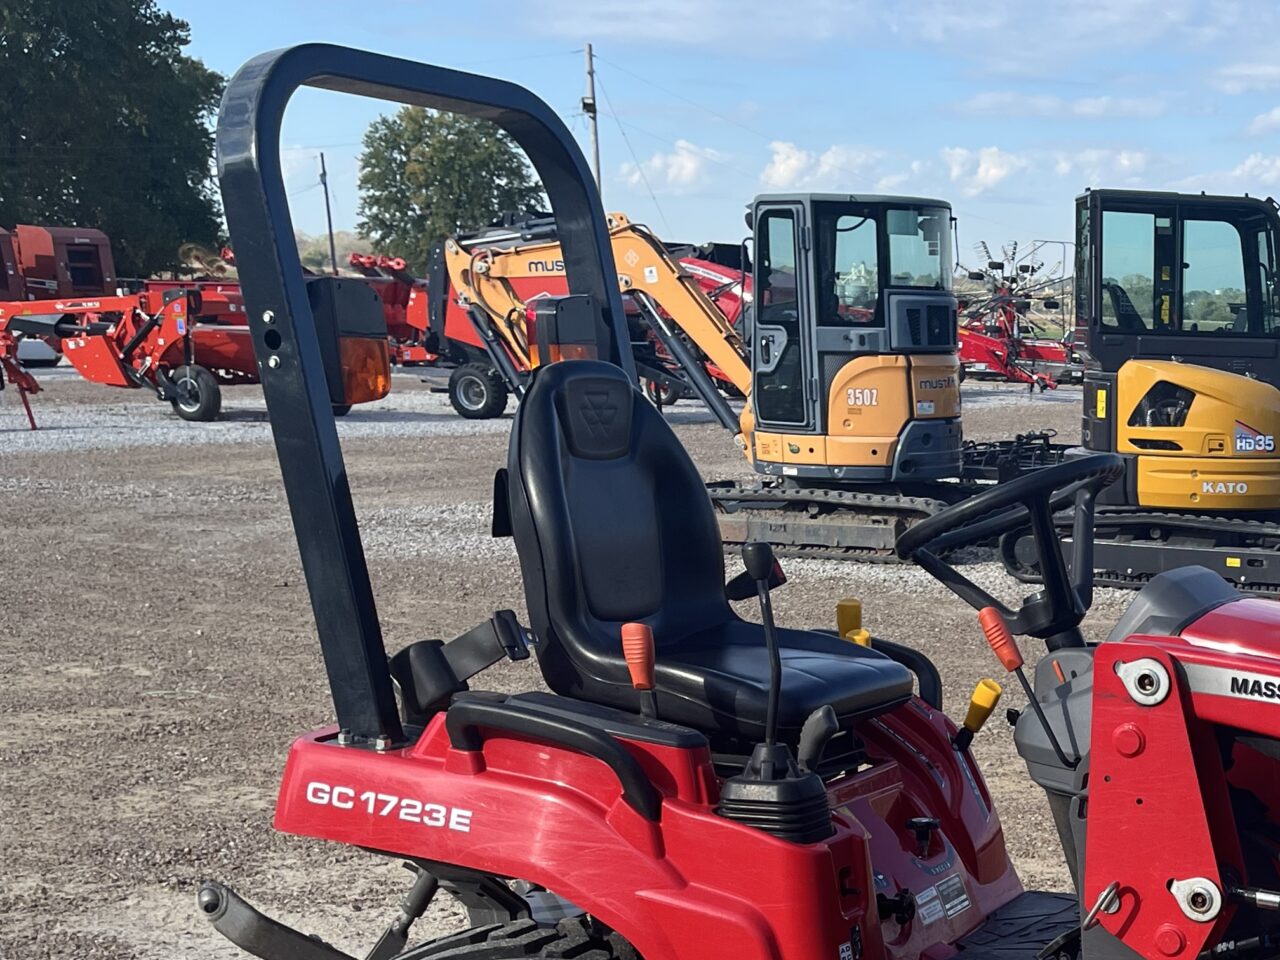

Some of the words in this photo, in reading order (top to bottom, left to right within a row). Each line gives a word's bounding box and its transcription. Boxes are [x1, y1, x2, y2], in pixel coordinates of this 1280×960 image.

[847, 388, 878, 406] 350Z
[1236, 435, 1275, 452] HD35
[1202, 481, 1248, 494] KATO
